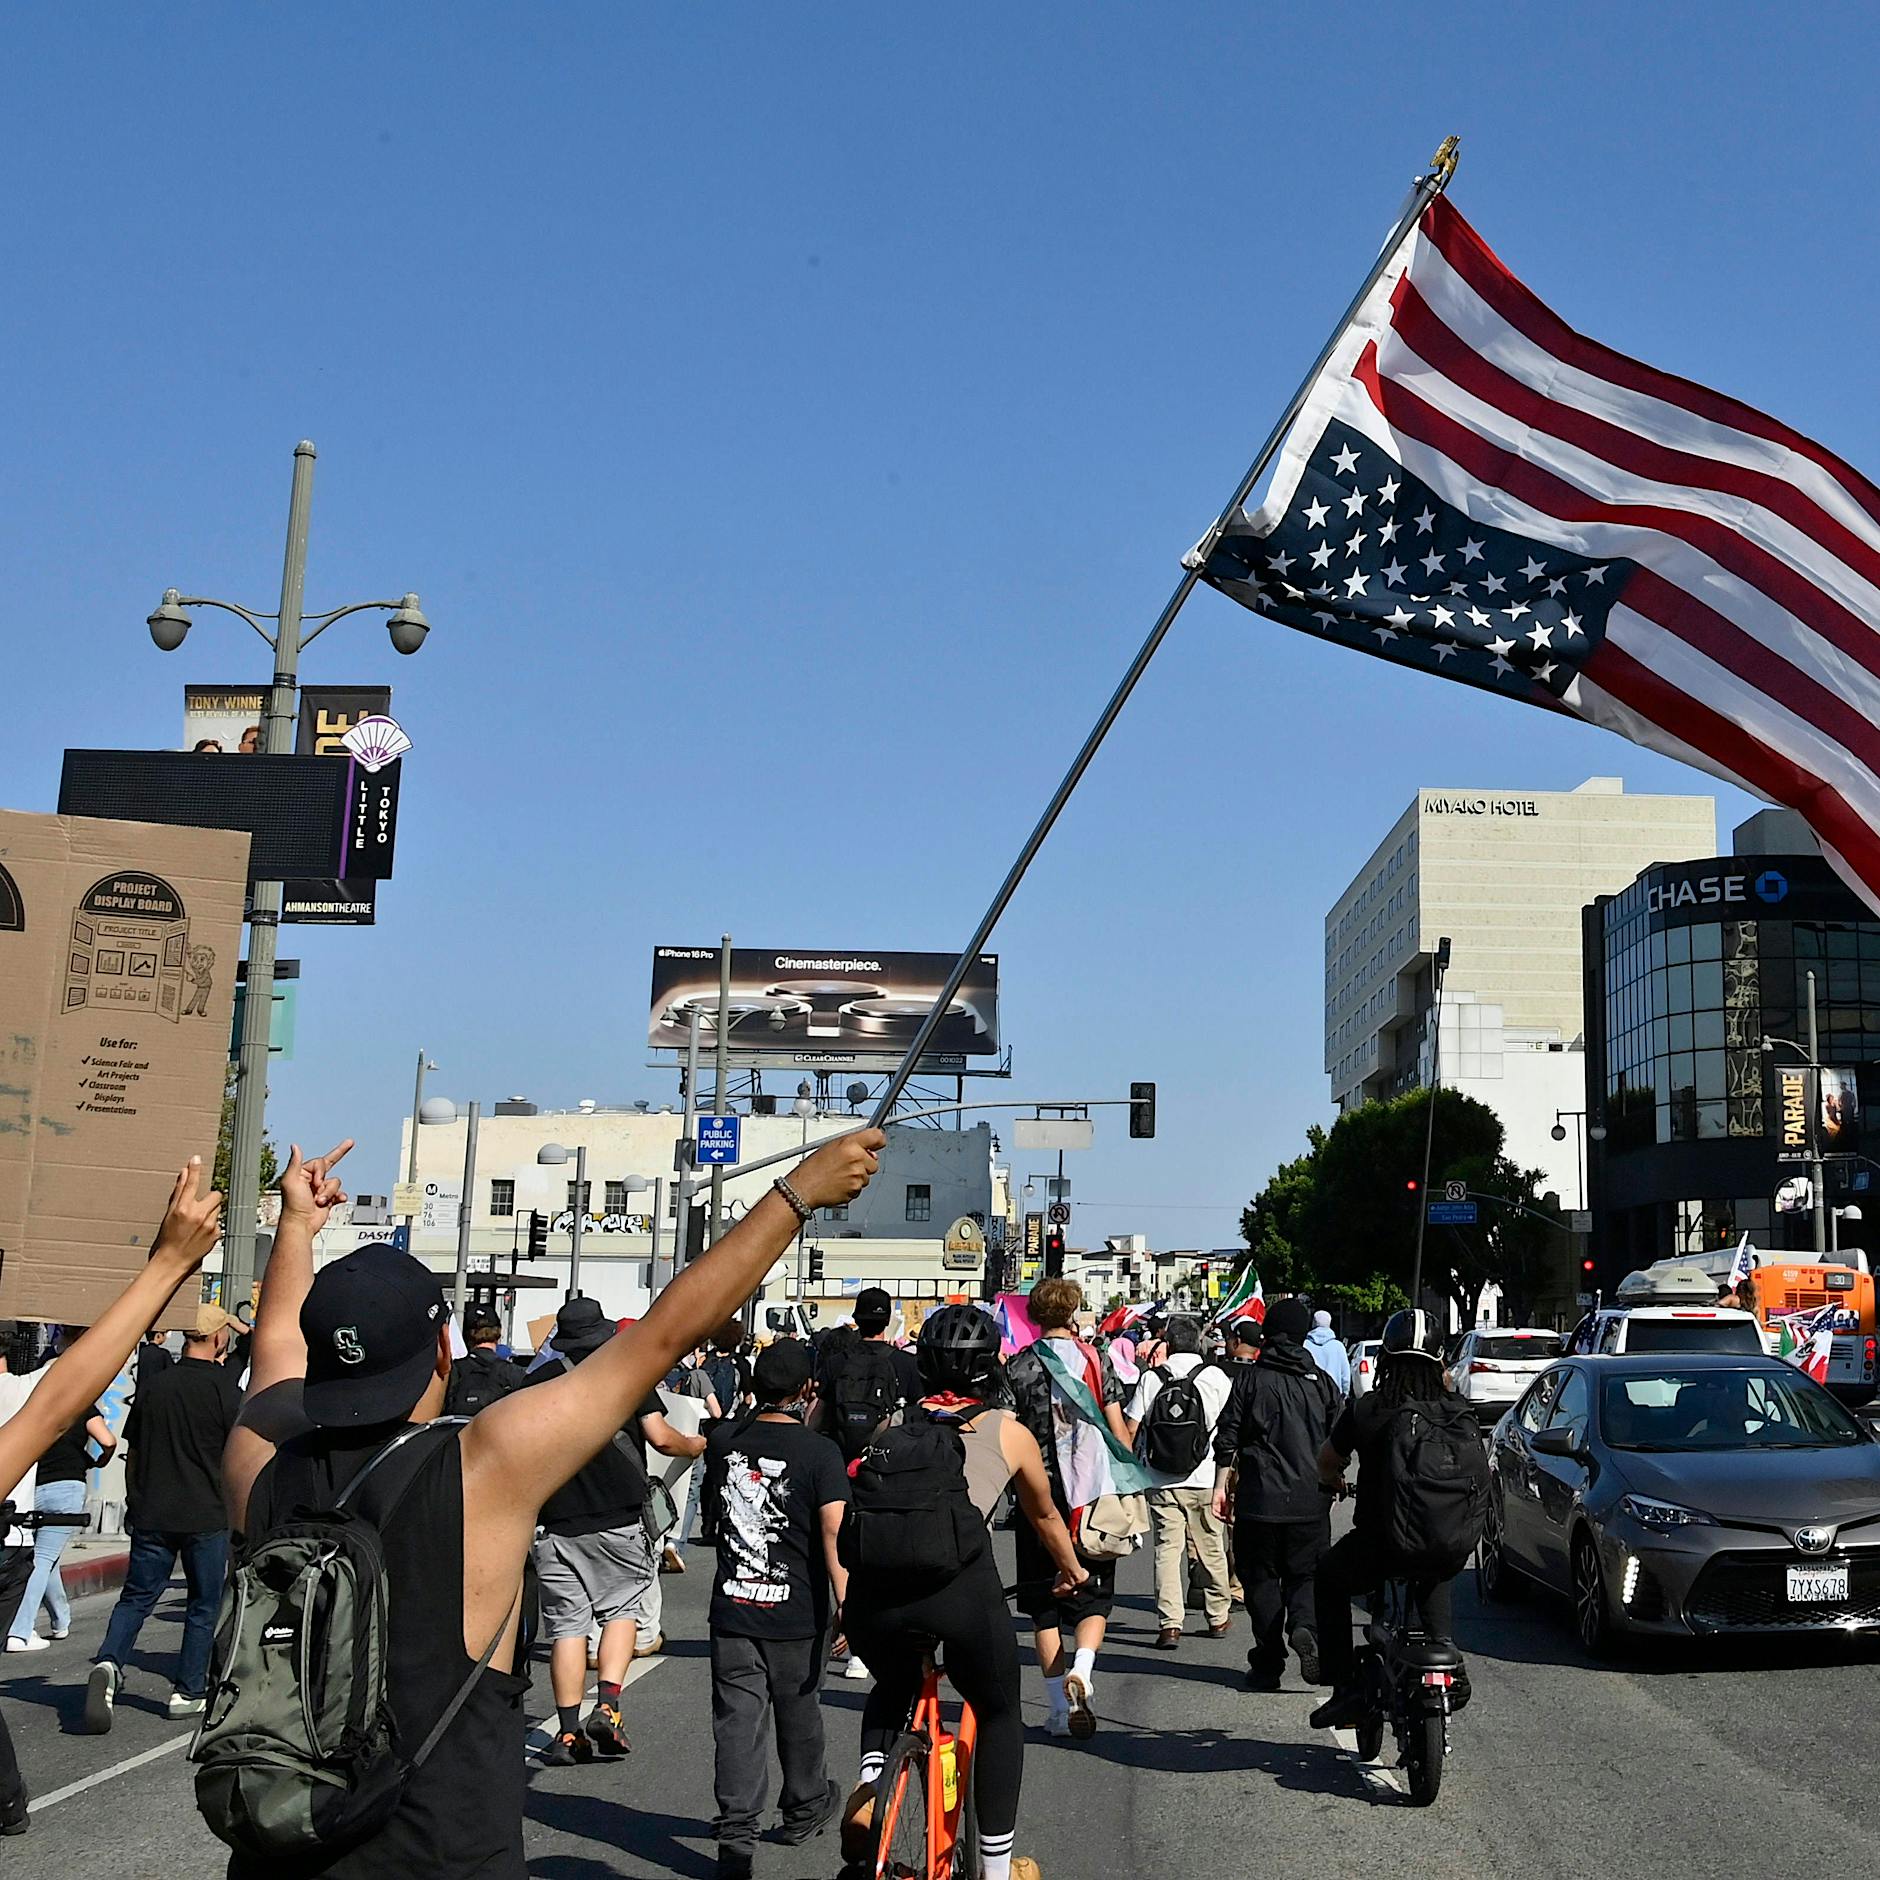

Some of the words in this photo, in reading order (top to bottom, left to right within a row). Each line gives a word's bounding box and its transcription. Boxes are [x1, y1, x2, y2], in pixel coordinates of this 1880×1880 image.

[189, 696, 219, 709] TONY
[1425, 798, 1487, 814] MIYAKO
[1491, 800, 1539, 816] HOTEL
[356, 781, 368, 848] LITTLE
[377, 787, 391, 843] TOKYO
[113, 881, 158, 896] PROJECT
[1648, 876, 1746, 913] CHASE
[94, 895, 136, 909] DISPLAY
[137, 899, 173, 912] BOARD
[104, 925, 136, 935] PROJECT
[137, 927, 157, 936] TITLE
[691, 950, 701, 958] 16
[701, 951, 714, 959] Pro
[775, 957, 882, 972] Cinemasterpiece.
[100, 1037, 118, 1048] Use
[118, 1038, 138, 1050] for:
[91, 1058, 118, 1068] Science
[118, 1060, 134, 1069] Fair
[134, 1062, 149, 1070] and
[97, 1070, 110, 1078] Art
[110, 1071, 140, 1081] Projects
[88, 1081, 126, 1091] Classroom
[94, 1093, 125, 1103] Displays
[86, 1104, 137, 1115] Presentations
[1783, 1073, 1806, 1146] PARADE
[703, 1130, 733, 1139] PUBLIC
[700, 1140, 735, 1149] PARKING
[1028, 1218, 1040, 1255] PARADE
[1835, 1275, 1845, 1285] 30
[333, 1326, 365, 1364] S
[1790, 1578, 1846, 1596] 7YXS678
[1788, 1594, 1825, 1602] CULVER
[1827, 1593, 1849, 1601] CITY
